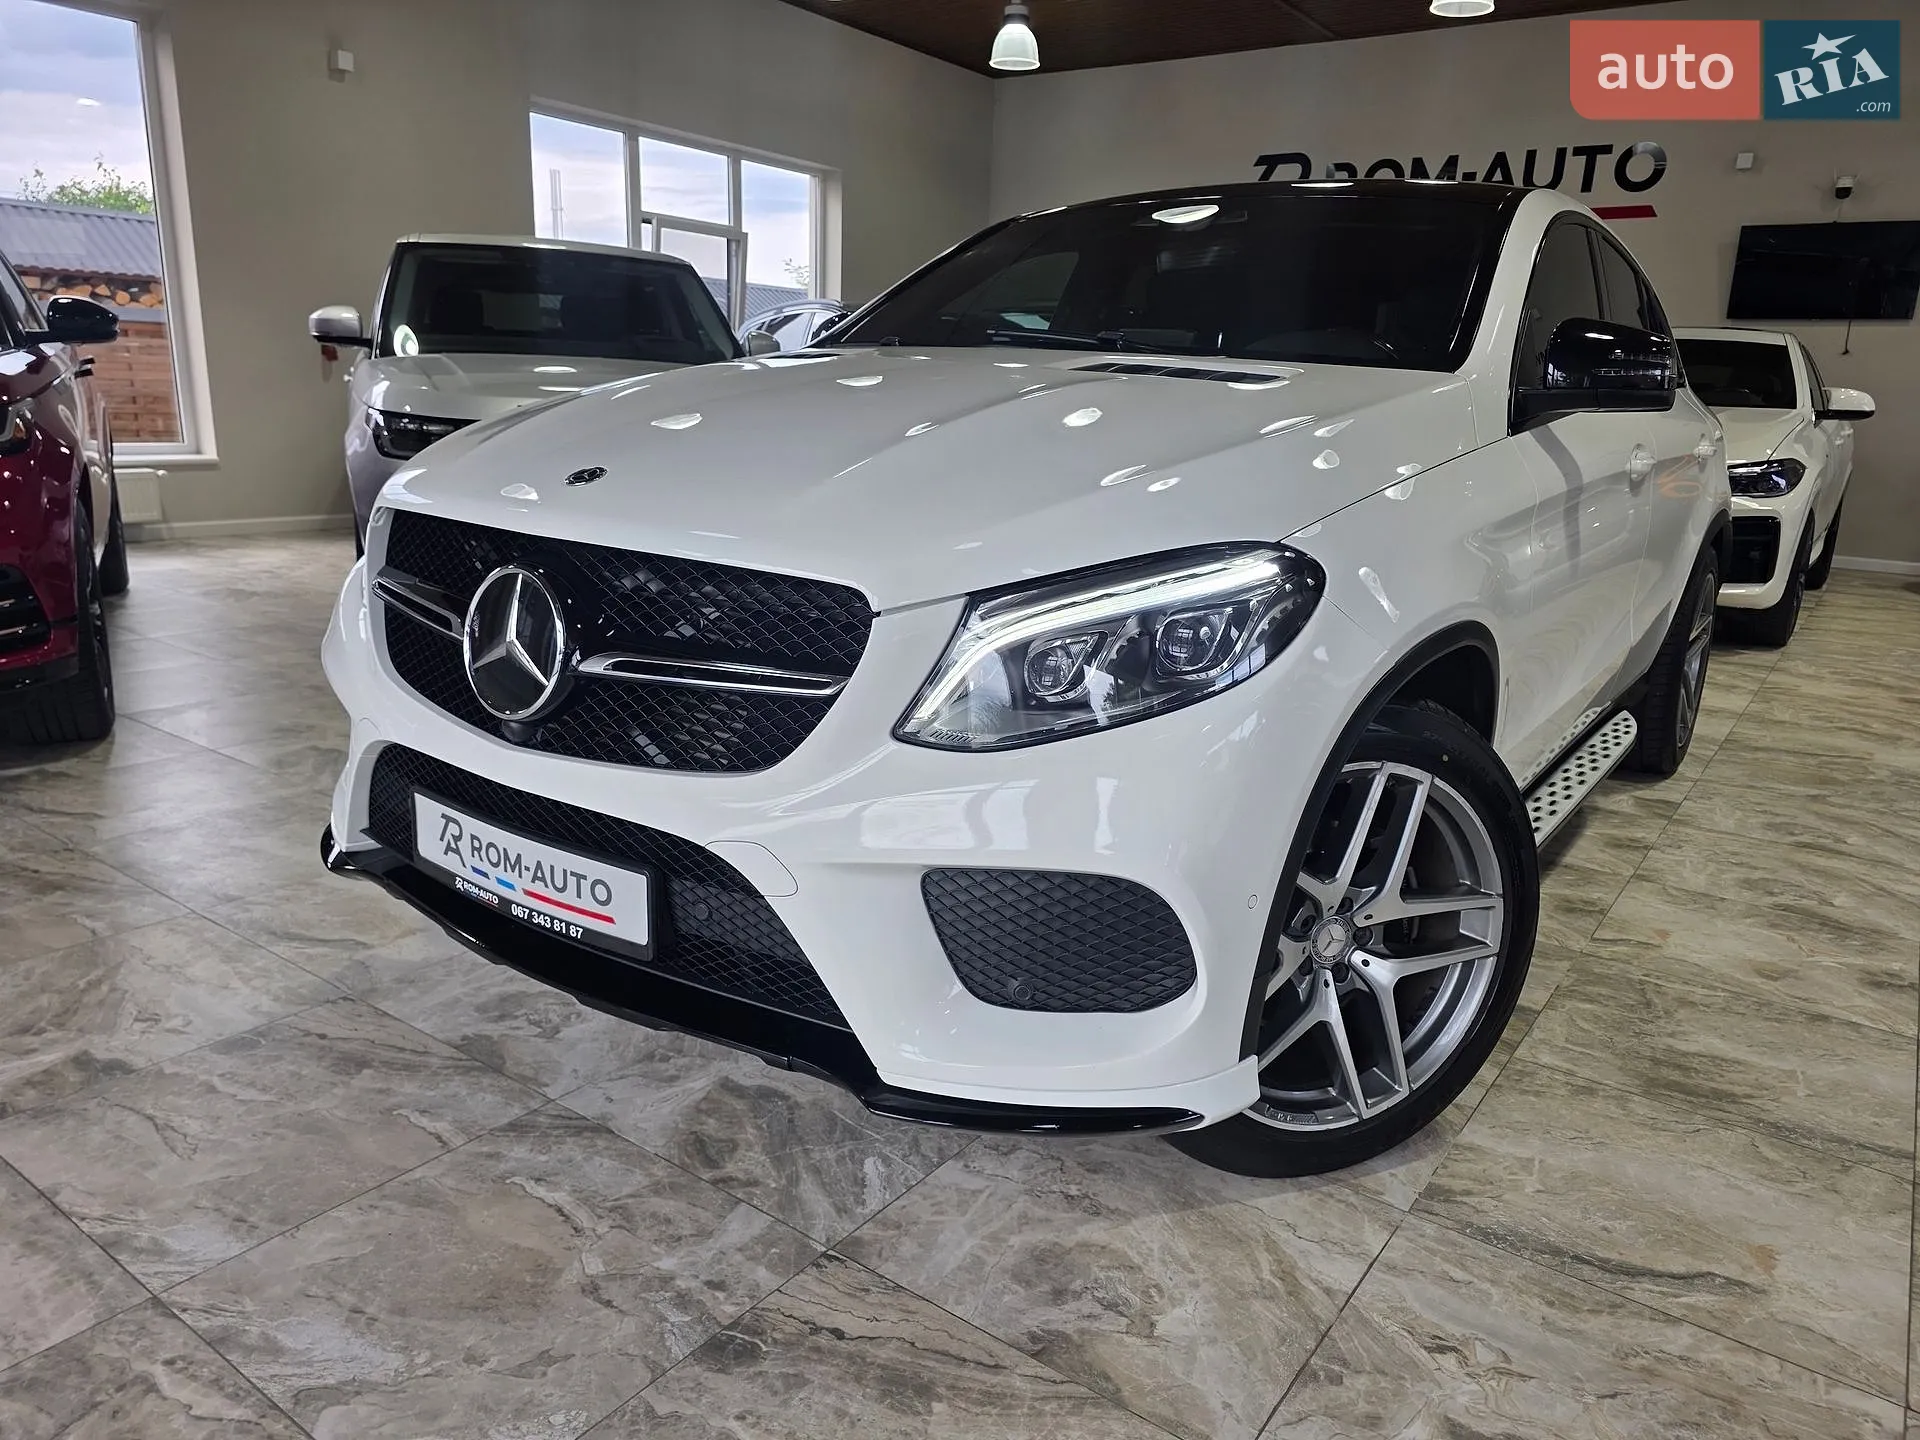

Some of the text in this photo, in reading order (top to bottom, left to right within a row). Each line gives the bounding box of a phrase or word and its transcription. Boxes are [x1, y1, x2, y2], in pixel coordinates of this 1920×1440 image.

[470, 833, 613, 907] ROM-AUTO
[463, 881, 499, 904] ROM-AUTO
[511, 904, 584, 939] 067 343 81 87
